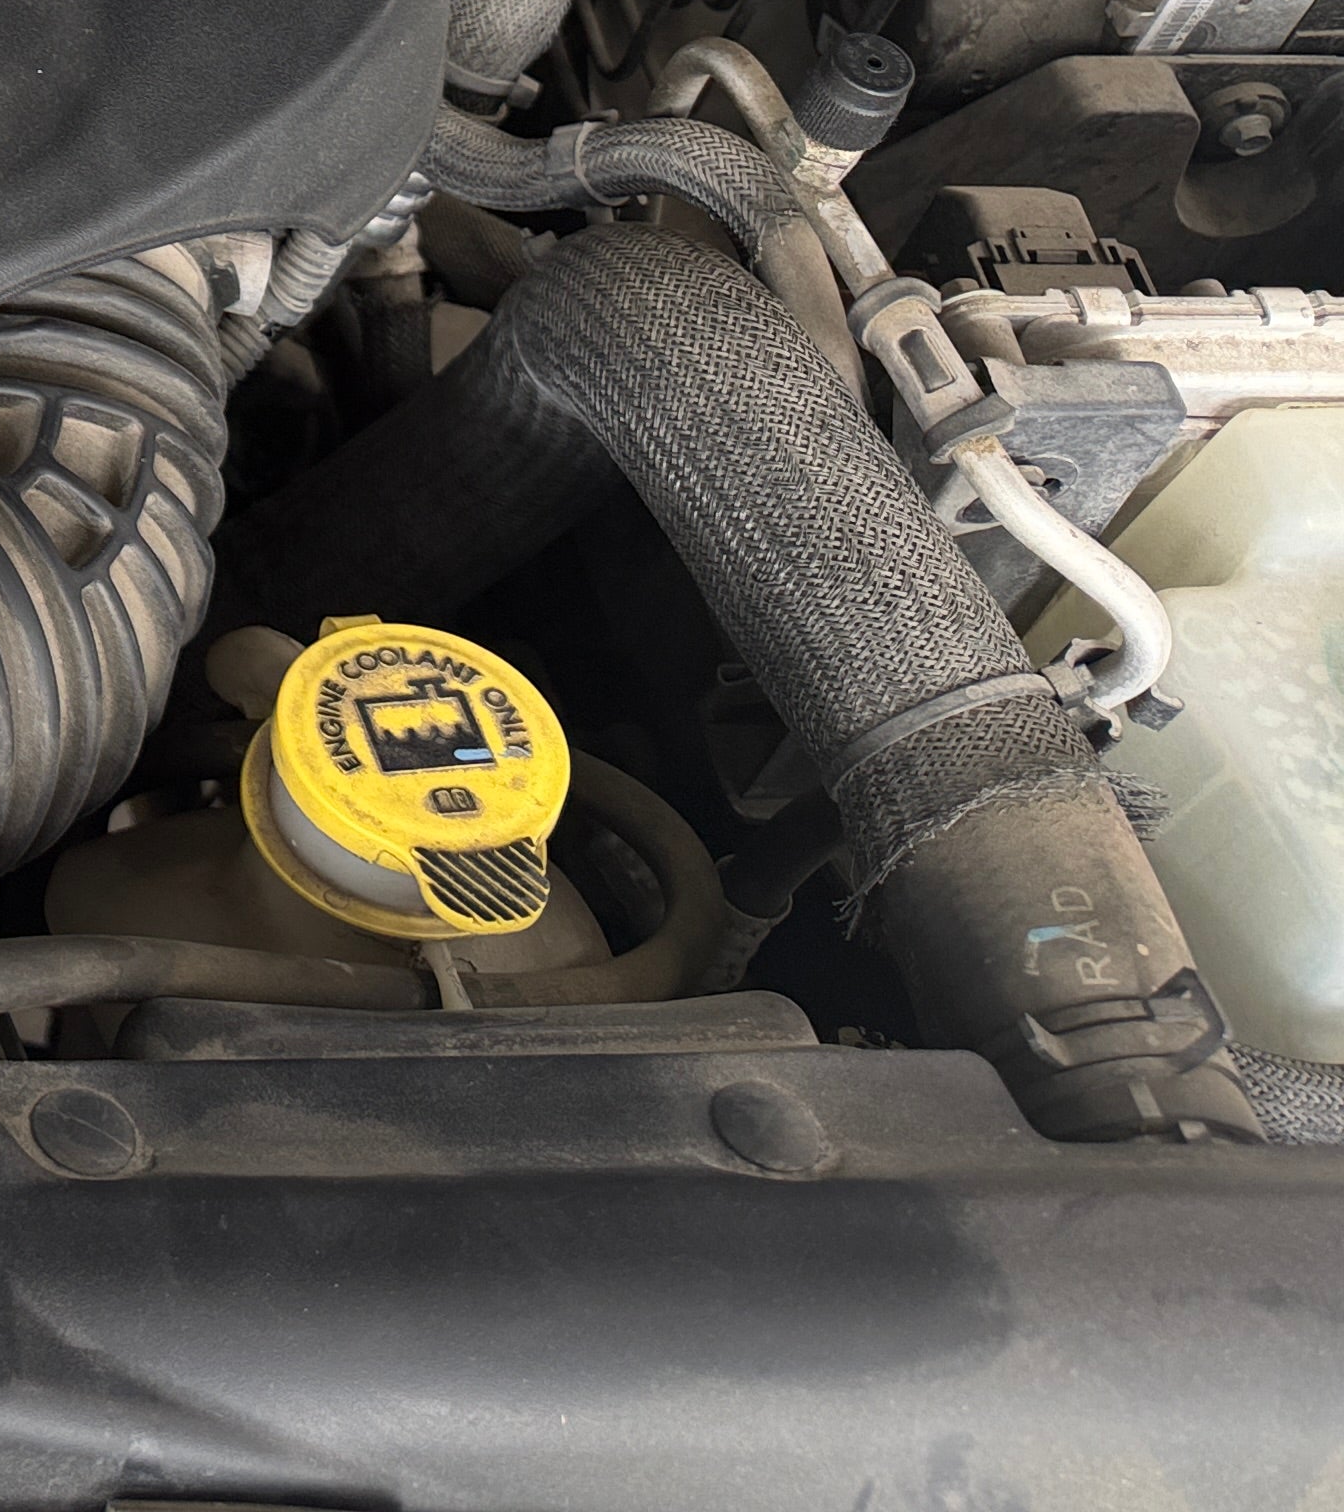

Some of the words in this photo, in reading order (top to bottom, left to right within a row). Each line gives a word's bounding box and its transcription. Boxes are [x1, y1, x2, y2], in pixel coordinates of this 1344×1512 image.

[338, 646, 486, 686] COOLANT
[316, 679, 362, 774] ENGINE
[481, 686, 533, 758] ONLY
[1051, 886, 1119, 986] RAD
